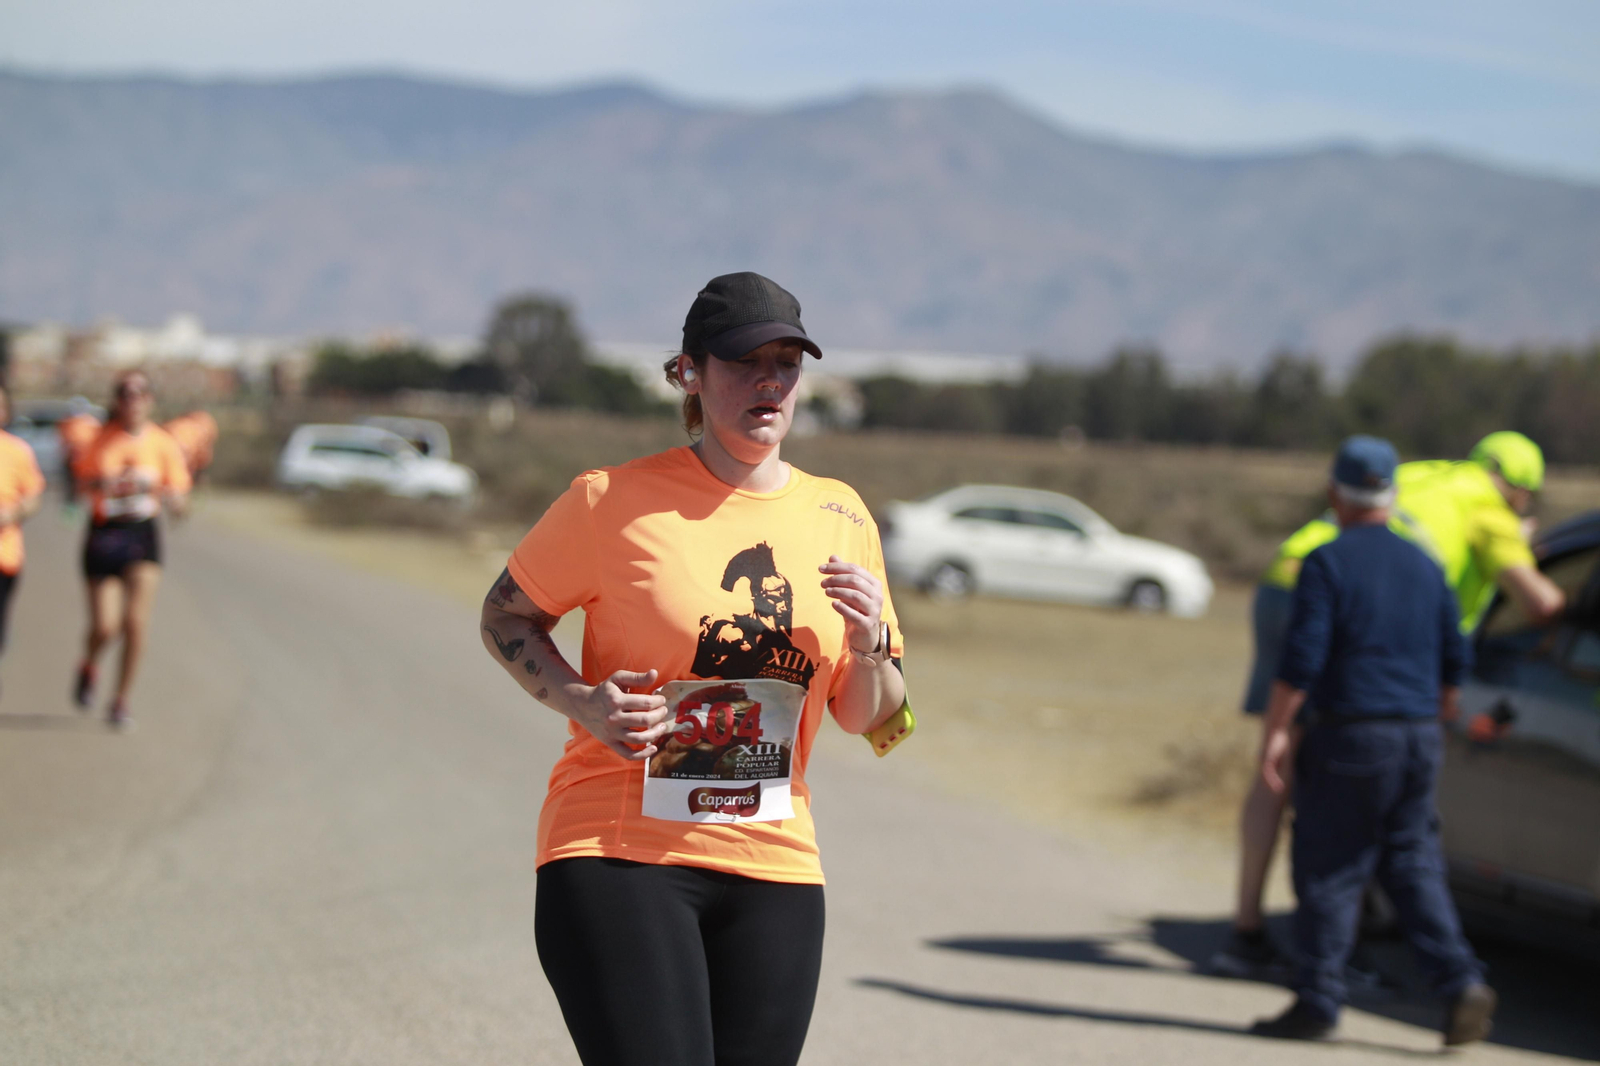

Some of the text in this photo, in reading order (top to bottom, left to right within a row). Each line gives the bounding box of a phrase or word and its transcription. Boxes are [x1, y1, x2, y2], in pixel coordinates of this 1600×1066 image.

[819, 502, 865, 527] JOLUVI
[766, 647, 808, 672] XIII
[762, 666, 803, 682] CARRERA
[673, 701, 764, 746] 504
[737, 744, 781, 755] XIII
